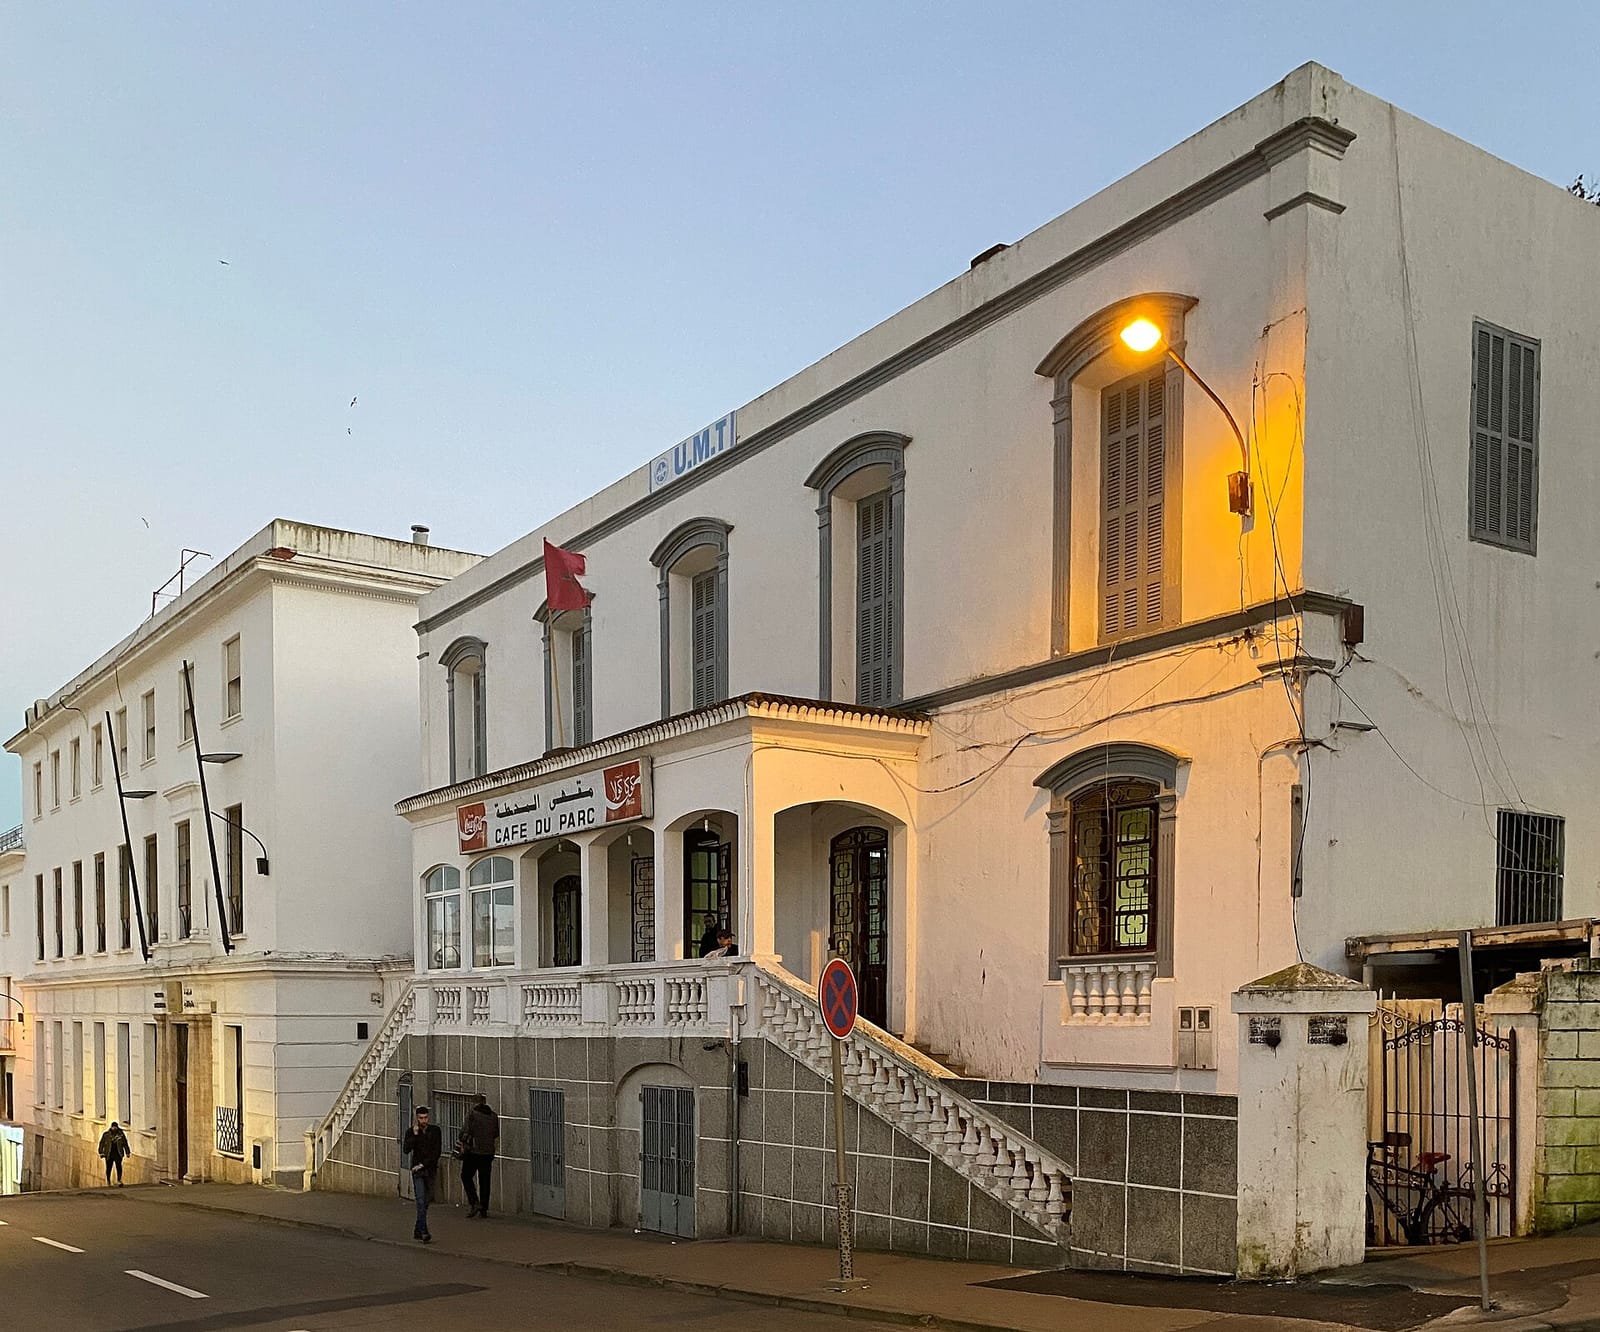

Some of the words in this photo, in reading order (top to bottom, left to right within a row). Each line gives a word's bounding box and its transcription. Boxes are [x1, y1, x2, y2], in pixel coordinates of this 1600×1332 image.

[549, 780, 594, 811] مقهى
[495, 823, 527, 844] CAFE
[535, 817, 551, 836] DU
[560, 807, 595, 831] PARC
